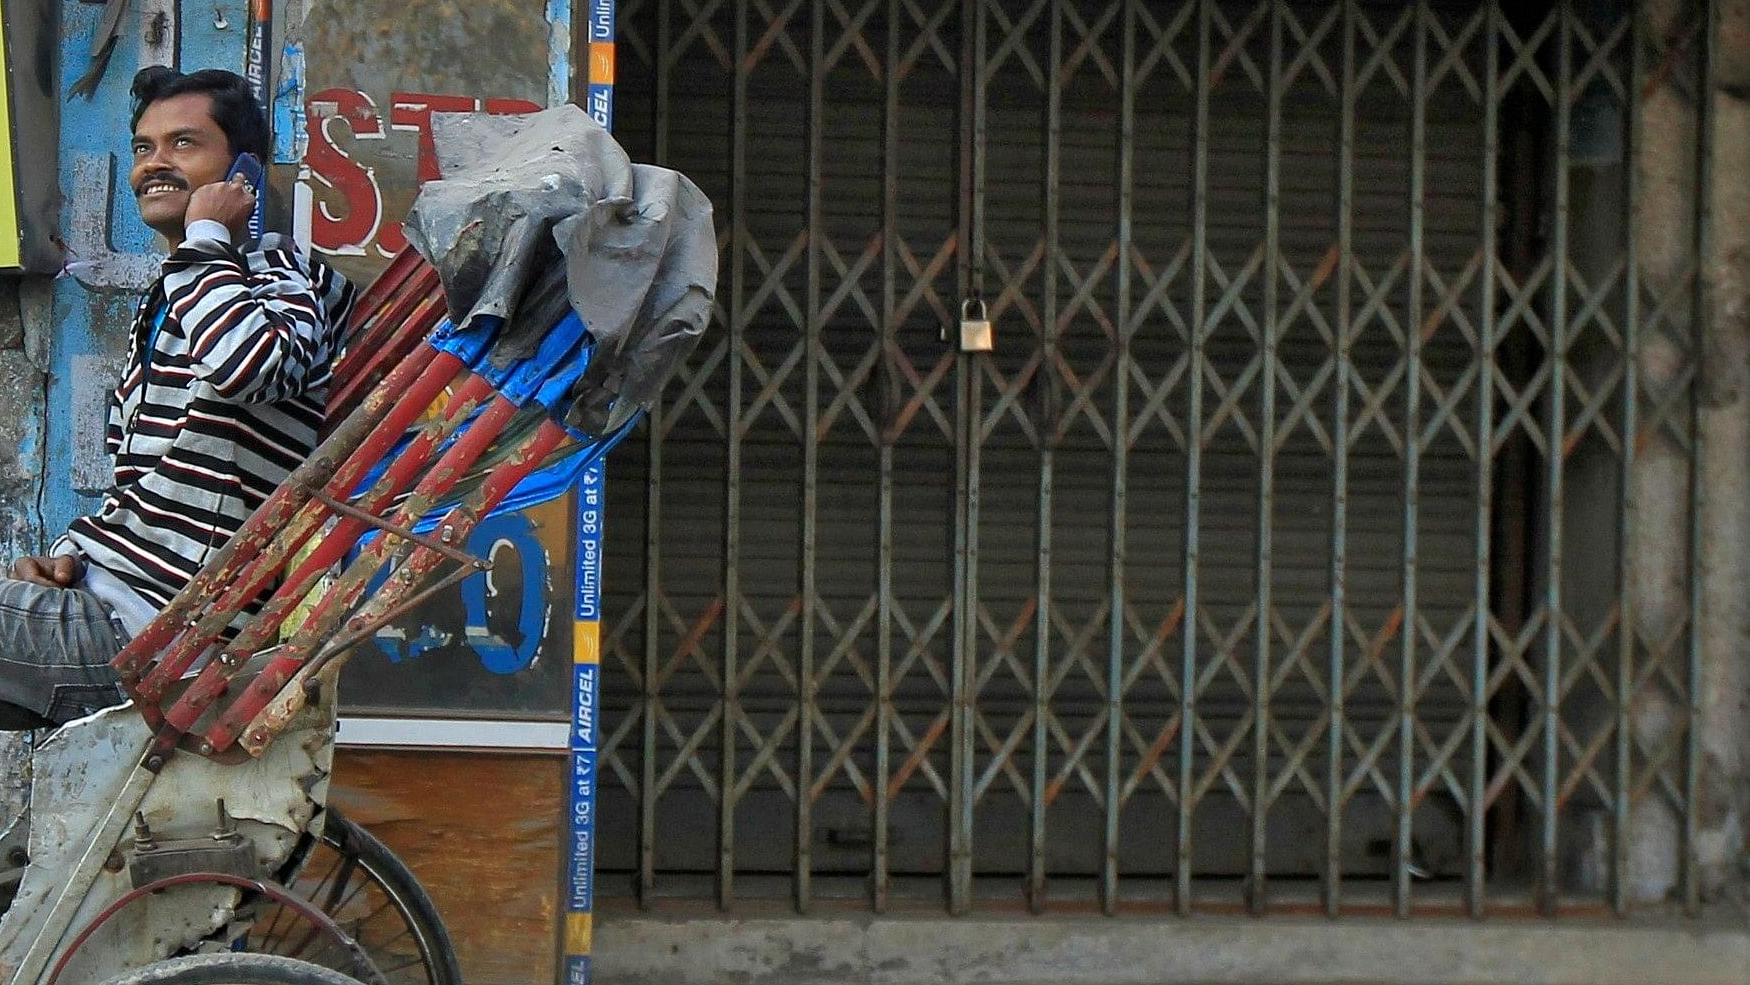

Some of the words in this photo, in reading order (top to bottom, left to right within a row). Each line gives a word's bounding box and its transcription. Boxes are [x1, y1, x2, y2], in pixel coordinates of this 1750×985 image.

[585, 487, 598, 506] at
[582, 509, 598, 534] 3G
[580, 538, 598, 617] Unlimited
[577, 668, 594, 744] AIRCEL
[576, 754, 592, 776] ₹7
[577, 779, 590, 797] at
[575, 801, 589, 826] 3G
[573, 830, 589, 909] Unlimited
